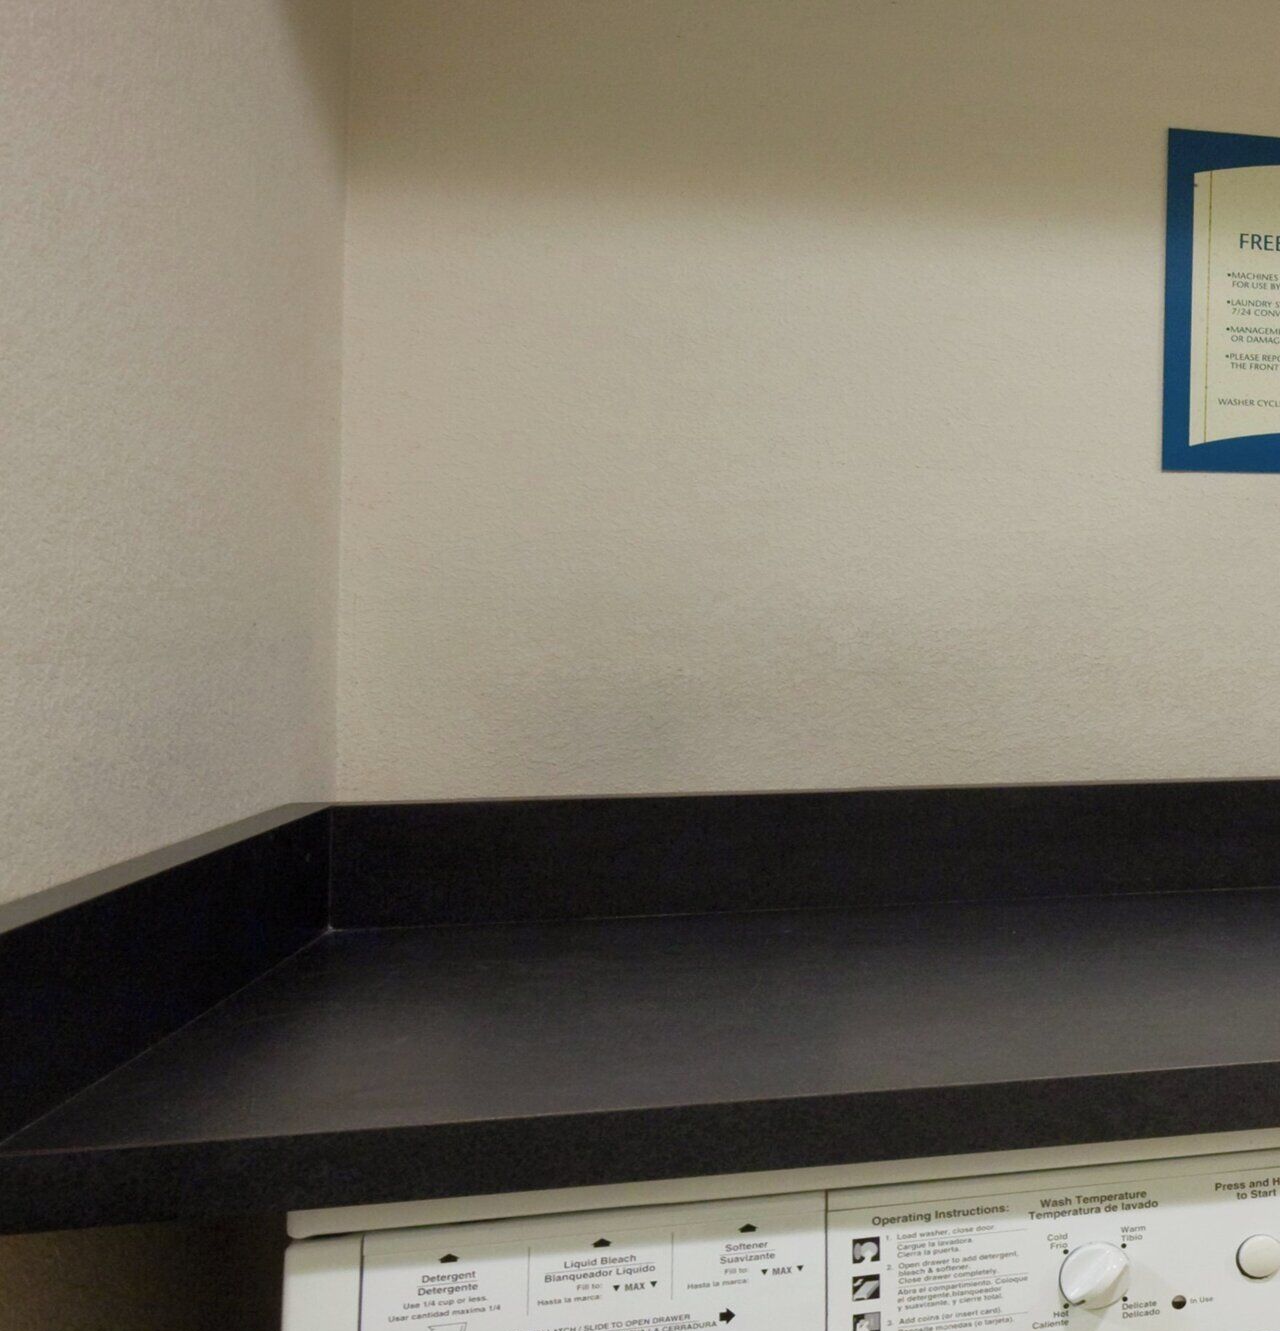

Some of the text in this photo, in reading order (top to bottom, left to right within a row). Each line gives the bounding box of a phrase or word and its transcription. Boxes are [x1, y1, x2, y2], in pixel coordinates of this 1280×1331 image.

[1232, 272, 1278, 282] MACHINES
[1232, 281, 1249, 289] FOR
[1252, 282, 1267, 290] USE
[1231, 299, 1272, 308] LAUNDRY
[1232, 308, 1251, 316] 7/24
[1230, 353, 1260, 361] PLEASE
[1230, 362, 1246, 370] THE
[1249, 363, 1279, 371] FRONT
[1218, 398, 1254, 407] WASHER
[1214, 1182, 1246, 1191] Press
[1249, 1178, 1269, 1188] and
[1040, 1190, 1147, 1208] Wash Temperature
[1237, 1189, 1277, 1200] to Start
[872, 1204, 1010, 1226] Operating Instructions:
[1028, 1200, 1159, 1220] Temperatura de lavado
[1121, 1225, 1146, 1233] Warm
[1047, 1233, 1068, 1242] Cold
[725, 1242, 768, 1252] Softener
[564, 1254, 637, 1269] Liquid Bleach
[720, 1252, 775, 1264] Suavizante
[772, 1266, 792, 1275] MAX
[422, 1271, 476, 1284] Detergent
[544, 1269, 613, 1283] Blanqueador
[418, 1283, 478, 1297] Detergente
[624, 1282, 645, 1291] MAX
[424, 1300, 436, 1308] 1/4
[438, 1299, 454, 1308] cup
[1122, 1300, 1157, 1310] Delicate
[388, 1314, 408, 1323] Usar
[411, 1310, 449, 1320] cantidad
[489, 1304, 501, 1312] 1/4
[1053, 1310, 1069, 1318] Hot
[1122, 1309, 1160, 1319] Delicado
[584, 1323, 609, 1331] SLIDE
[626, 1318, 650, 1327] OPEN
[652, 1314, 690, 1324] DRAWER
[662, 1321, 717, 1331] CERRADURA
[1032, 1319, 1069, 1330] Caliente
